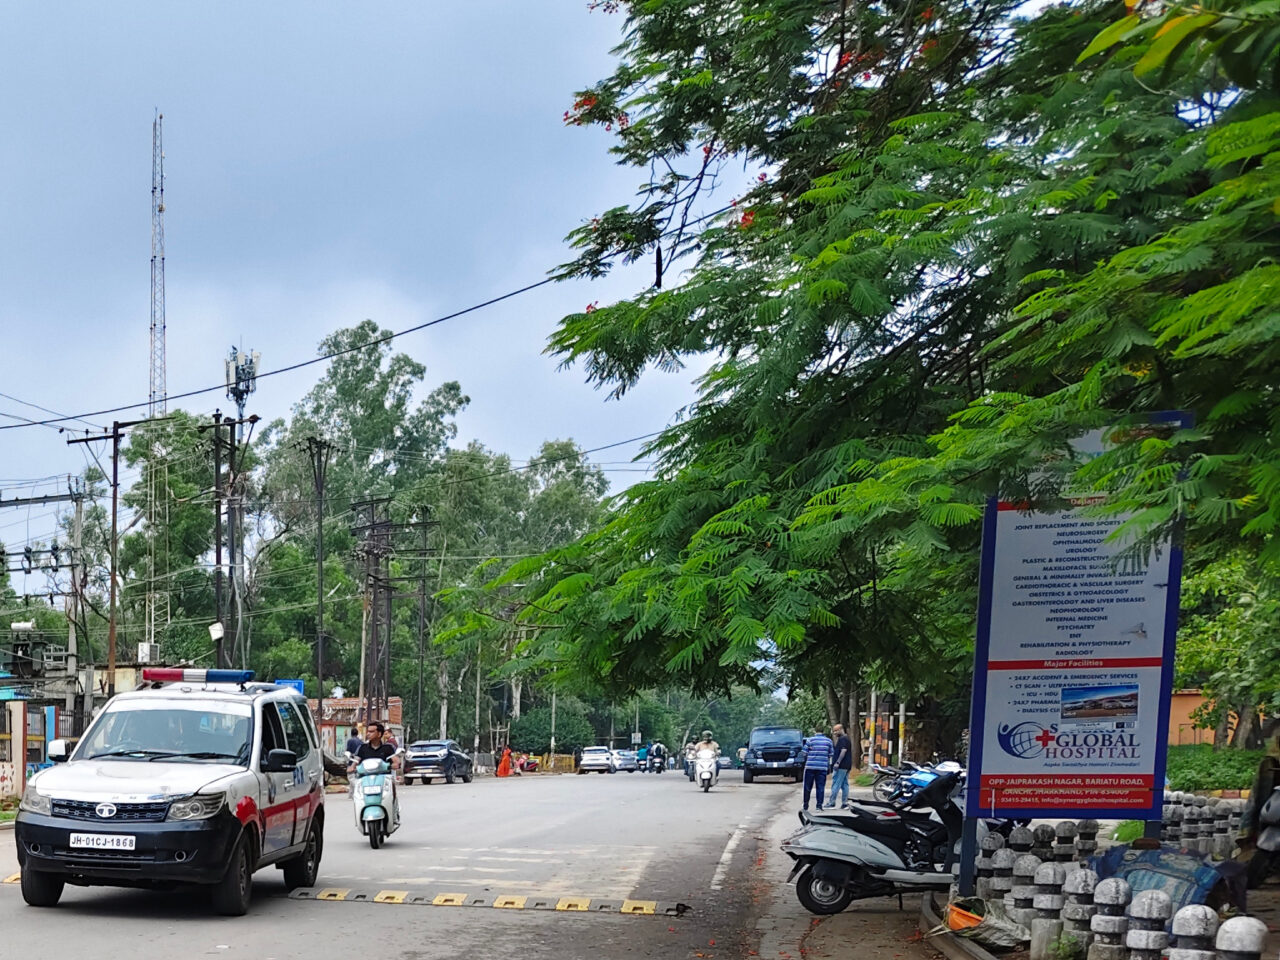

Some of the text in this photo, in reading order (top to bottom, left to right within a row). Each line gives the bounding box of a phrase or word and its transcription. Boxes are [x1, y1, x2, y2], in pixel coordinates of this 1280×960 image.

[1044, 659, 1103, 668] Major Facilities
[1055, 732, 1141, 748] GLOBAL
[1045, 746, 1141, 760] HOSPITAL
[72, 835, 134, 848] JH-01CJ-1868
